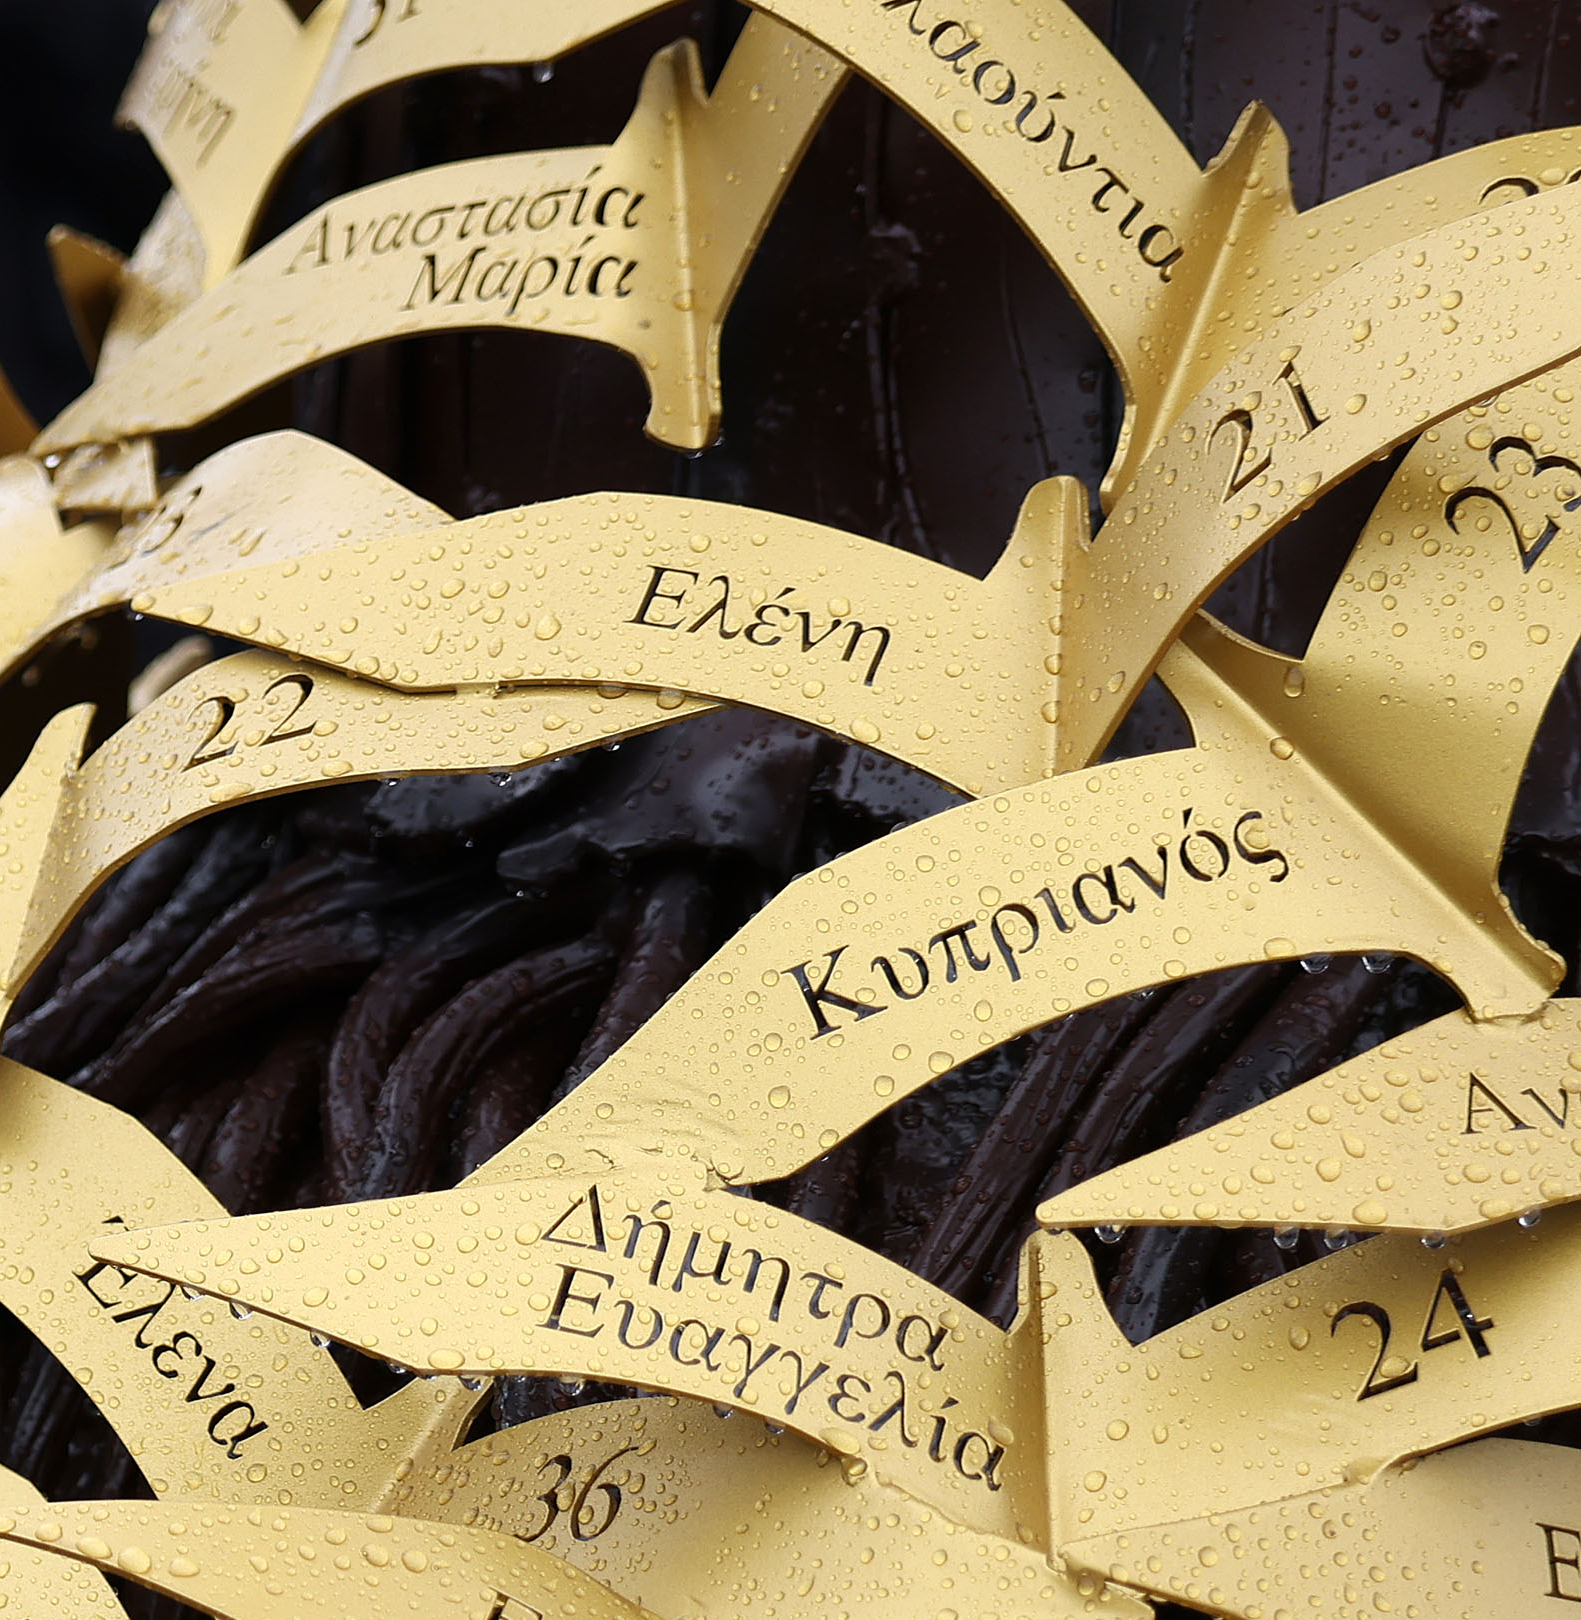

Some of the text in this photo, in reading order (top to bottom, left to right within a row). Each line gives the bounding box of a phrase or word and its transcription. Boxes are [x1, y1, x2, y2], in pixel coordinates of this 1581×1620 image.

[282, 165, 646, 276] Αναστασία
[400, 233, 640, 318] Μαρία
[1205, 361, 1331, 503] 21
[1444, 436, 1581, 575] 23
[623, 565, 893, 687] Ελένη
[181, 673, 318, 772] 22
[780, 808, 1290, 1040] Κυπριανός
[1459, 1071, 1581, 1135] Αν
[541, 1184, 949, 1373] Δήμητρα
[1331, 1267, 1495, 1402] 24
[536, 1263, 1007, 1492] Ευαγγελία
[513, 1446, 640, 1542] 36
